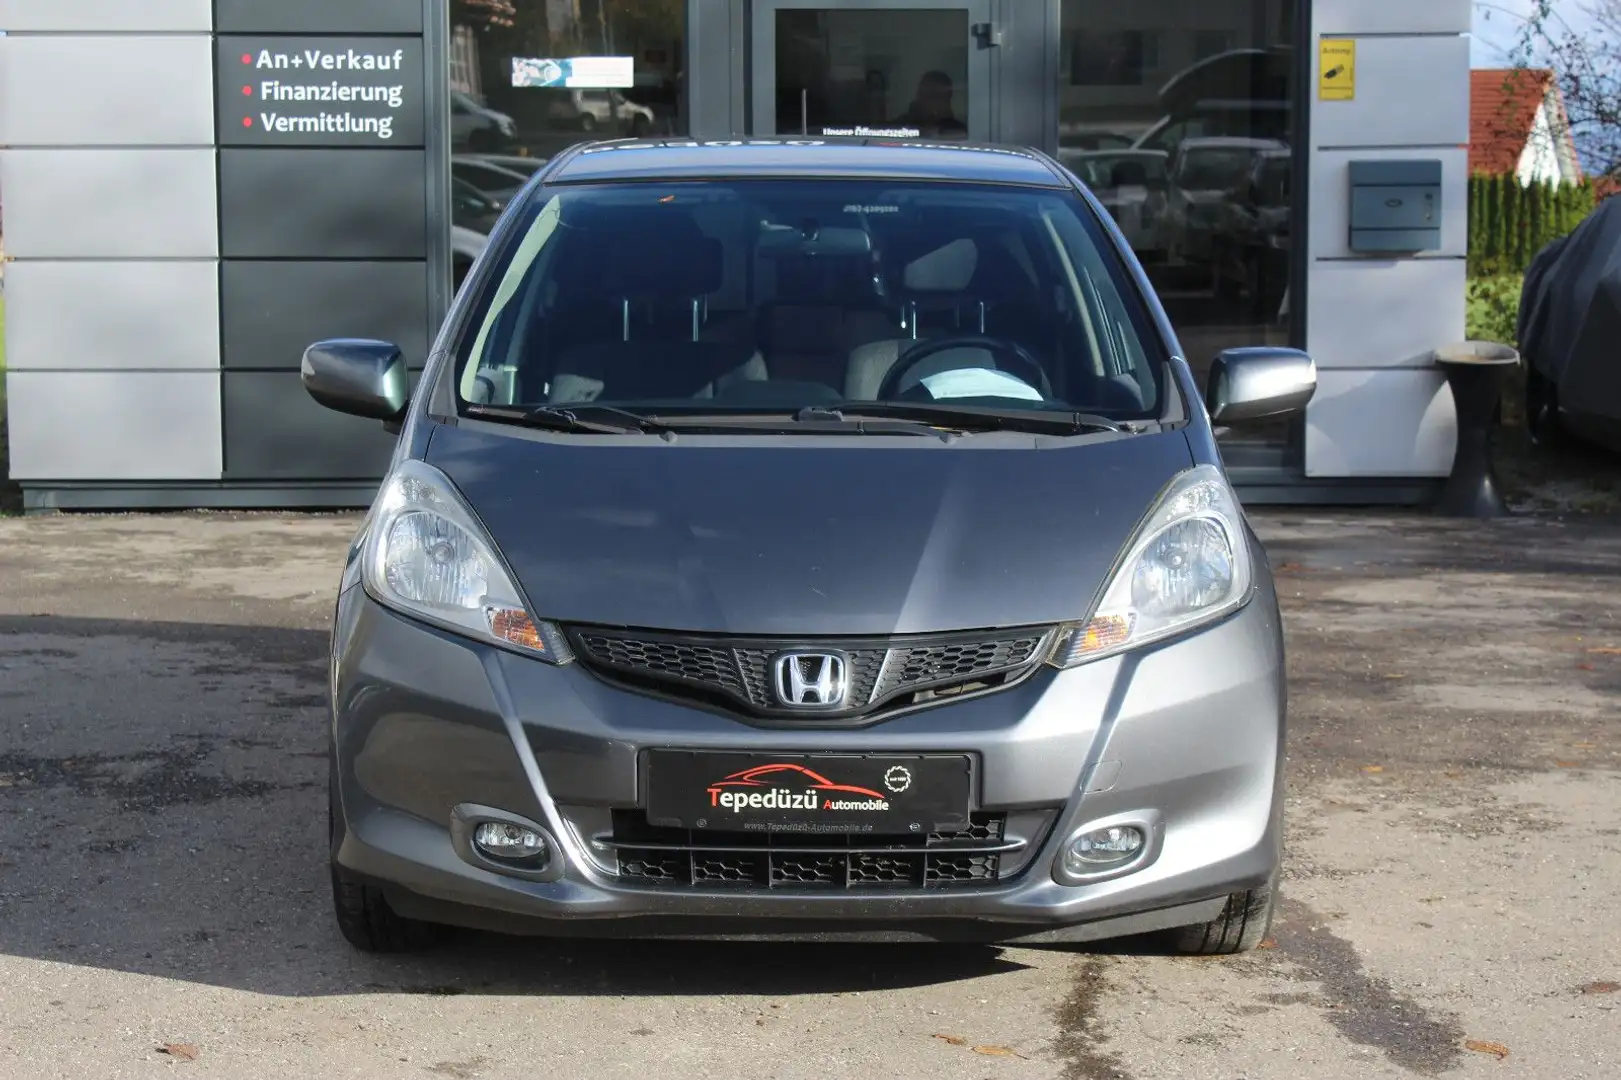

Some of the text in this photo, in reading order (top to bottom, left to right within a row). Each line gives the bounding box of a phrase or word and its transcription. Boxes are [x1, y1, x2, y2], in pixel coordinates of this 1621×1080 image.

[255, 49, 403, 70] An+Verkauf
[260, 80, 403, 107] Finanzierung
[260, 112, 393, 138] Vermittlung
[707, 788, 890, 813] Tepedüzü Automobile
